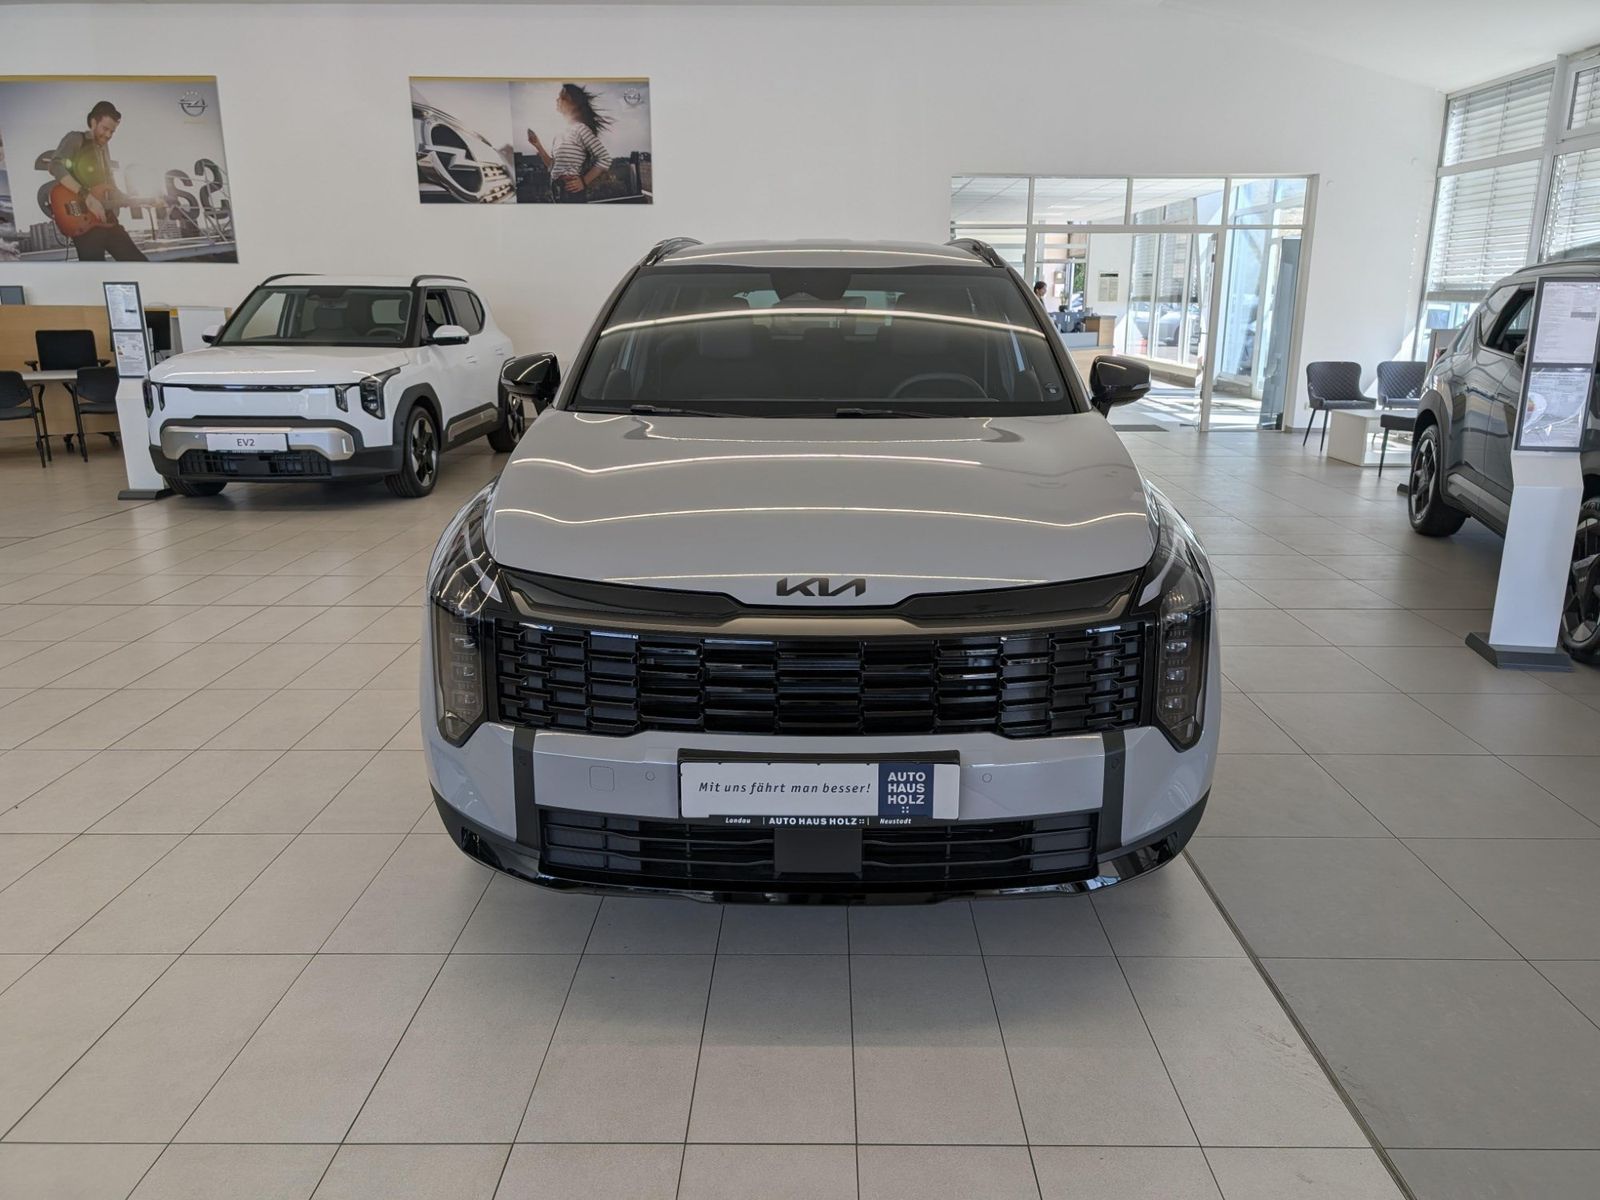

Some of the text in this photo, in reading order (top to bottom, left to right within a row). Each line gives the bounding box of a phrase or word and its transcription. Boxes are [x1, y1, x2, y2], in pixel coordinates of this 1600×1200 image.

[236, 438, 255, 447] EV2
[776, 577, 866, 597] KIA
[887, 771, 926, 782] AUTO
[699, 782, 871, 795] Mit uns fährt man besser!
[887, 783, 925, 793] HAUS
[887, 794, 925, 805] HOLZ
[768, 817, 857, 825] AUTO HAUS HOLZ
